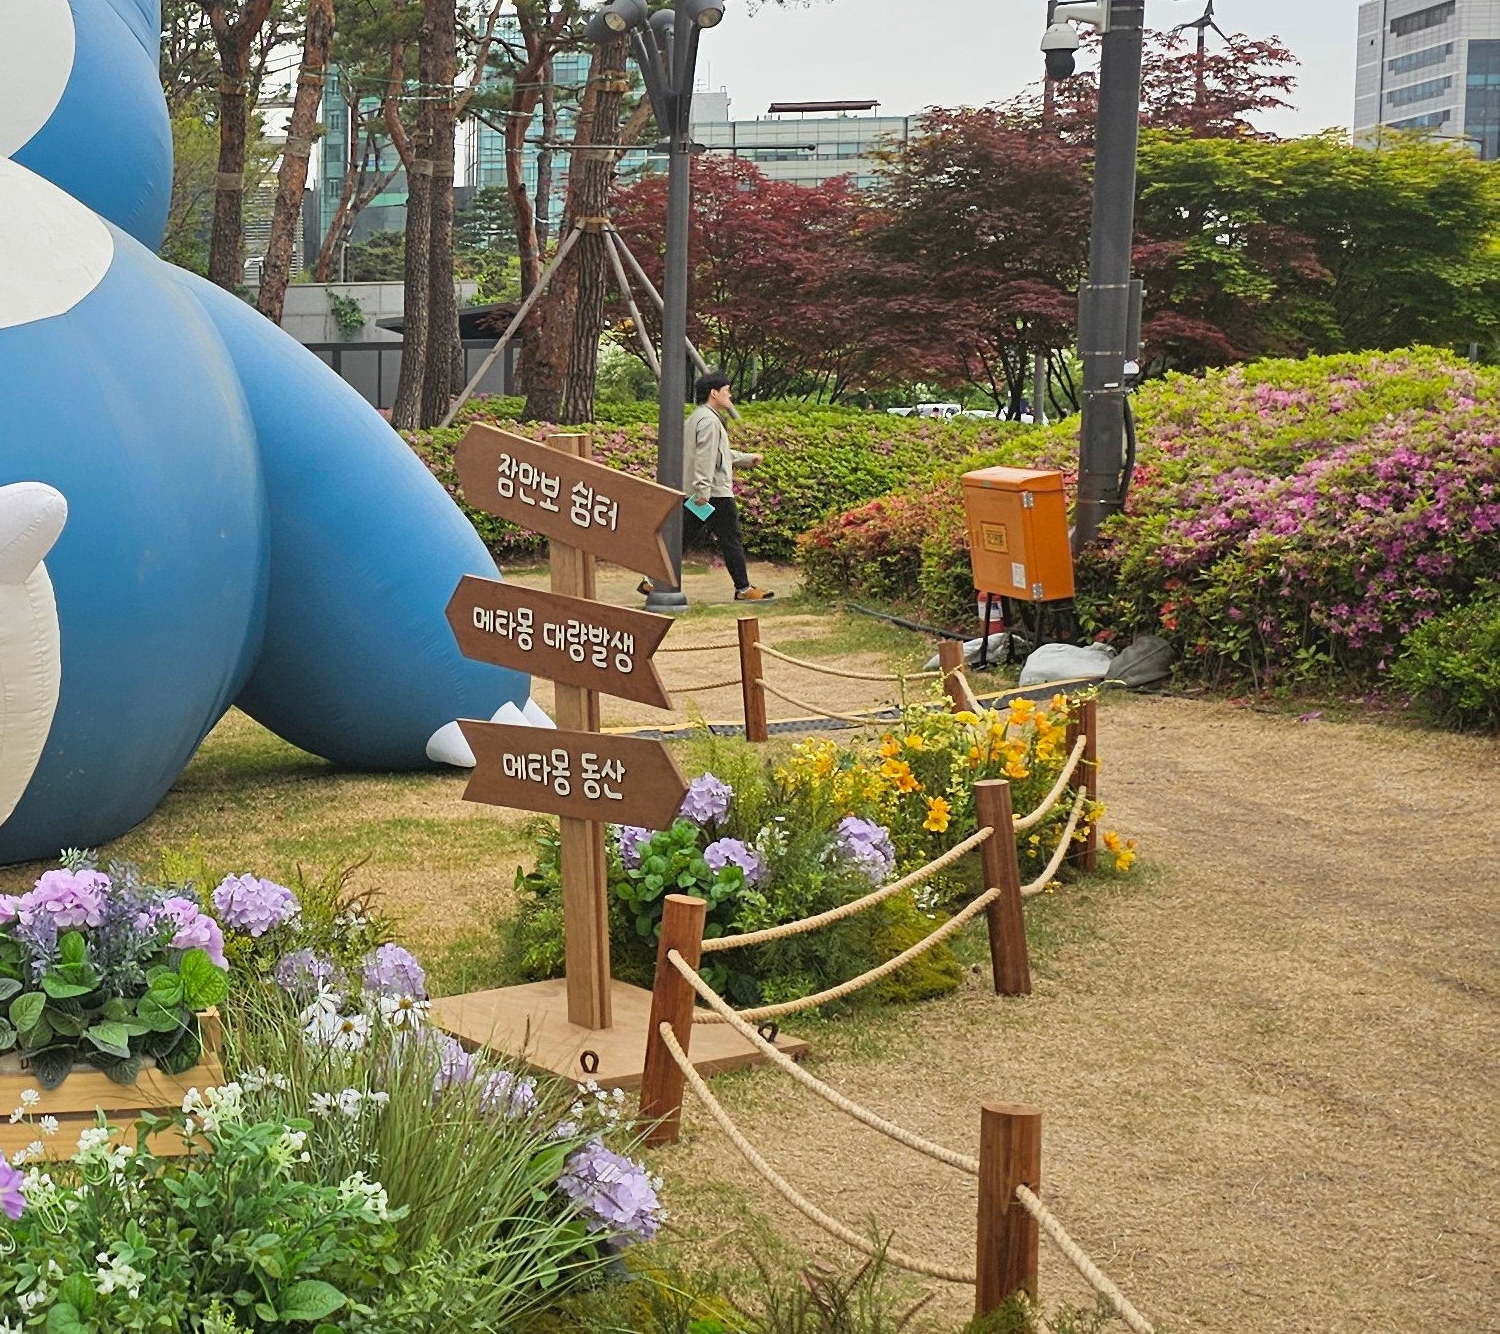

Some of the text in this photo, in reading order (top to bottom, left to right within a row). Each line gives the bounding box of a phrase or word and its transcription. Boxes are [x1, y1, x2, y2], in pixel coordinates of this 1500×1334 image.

[498, 453, 618, 531] 잠만보 쉼터
[473, 606, 634, 674] 메타몽 대량발생
[502, 748, 626, 800] 메타몽 동산
